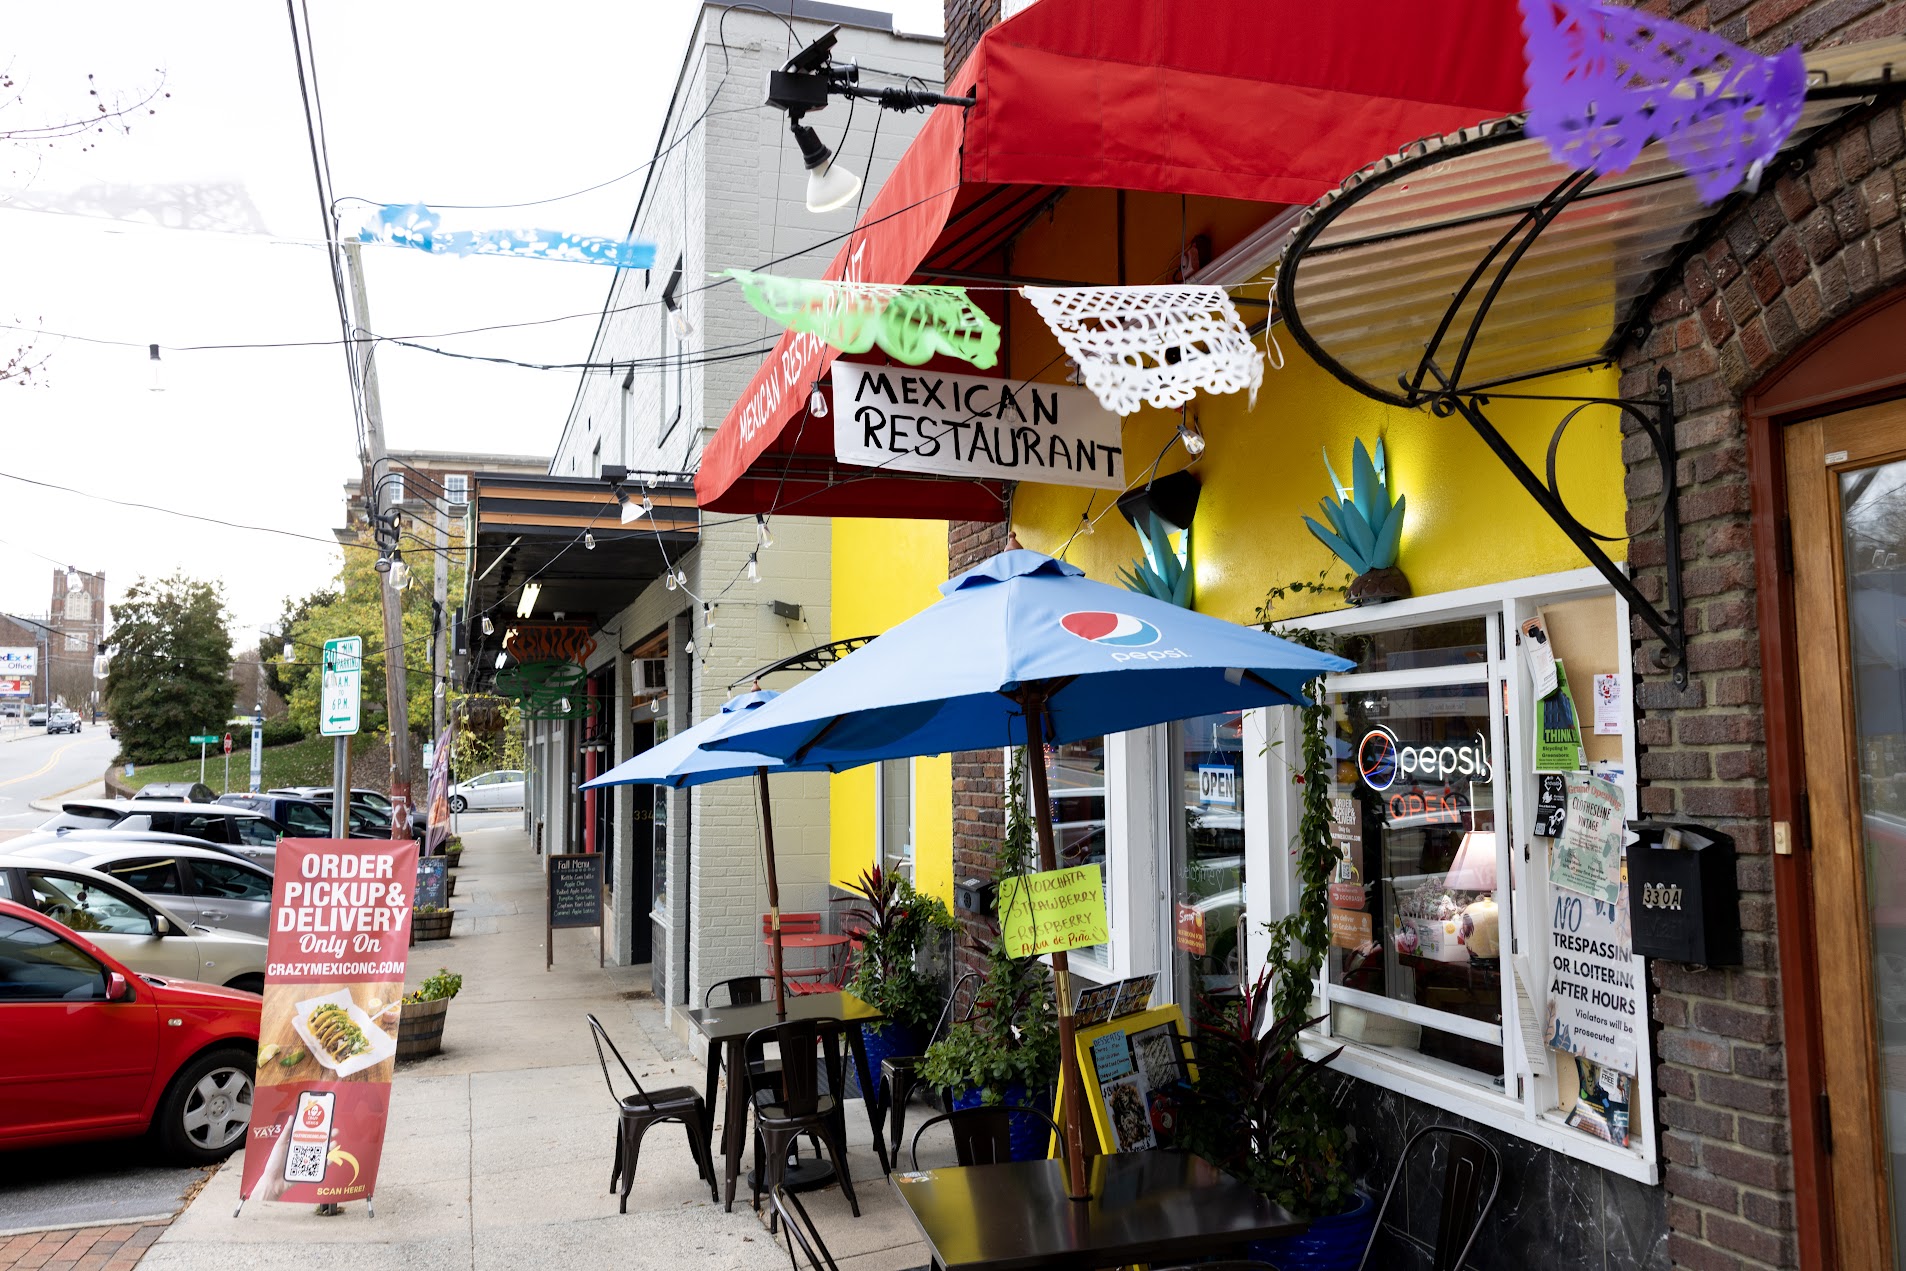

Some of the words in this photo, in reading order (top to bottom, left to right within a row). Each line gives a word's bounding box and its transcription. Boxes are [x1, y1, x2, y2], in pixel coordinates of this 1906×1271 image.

[854, 371, 1058, 426] MEXICAN
[738, 367, 780, 449] MEXICAN
[854, 406, 1122, 477] RESTAURANT
[343, 643, 353, 654] MIN
[1111, 647, 1188, 663] pepsi
[8, 662, 32, 670] Office
[336, 657, 359, 670] PARKING
[1545, 729, 1573, 742] THINK
[1201, 771, 1234, 798] OPEN
[1335, 798, 1352, 808] ORDER
[1568, 785, 1590, 794] Grand
[1591, 786, 1622, 811] Opening
[634, 809, 653, 821] 334
[1390, 793, 1458, 823] OPEN
[1572, 797, 1611, 820] CLOTHESLINE
[1578, 815, 1599, 832] VINTAGE
[302, 853, 394, 878] ORDER
[558, 860, 570, 870] Fall
[572, 860, 590, 869] Menu
[1019, 871, 1086, 895] HORCHATA
[283, 882, 406, 906] PICKUP&
[1644, 889, 1679, 905] 330A
[277, 907, 409, 932] DELIVERY
[1554, 896, 1582, 932] NO
[299, 934, 348, 959] Only
[353, 934, 382, 953] On
[1053, 936, 1066, 945] de
[268, 962, 404, 976] CRAZYMEXICONC.COM
[1553, 956, 1570, 974] OR
[1551, 979, 1588, 1002] AFTER
[1592, 989, 1635, 1015] HOURS
[1575, 1008, 1608, 1026] Violators
[1609, 1020, 1622, 1031] will
[1624, 1022, 1633, 1033] be
[1574, 1027, 1615, 1044] prosecuted
[1602, 1074, 1614, 1085] FREE
[316, 1186, 342, 1196] SCAN
[343, 1184, 365, 1195] HERE!
